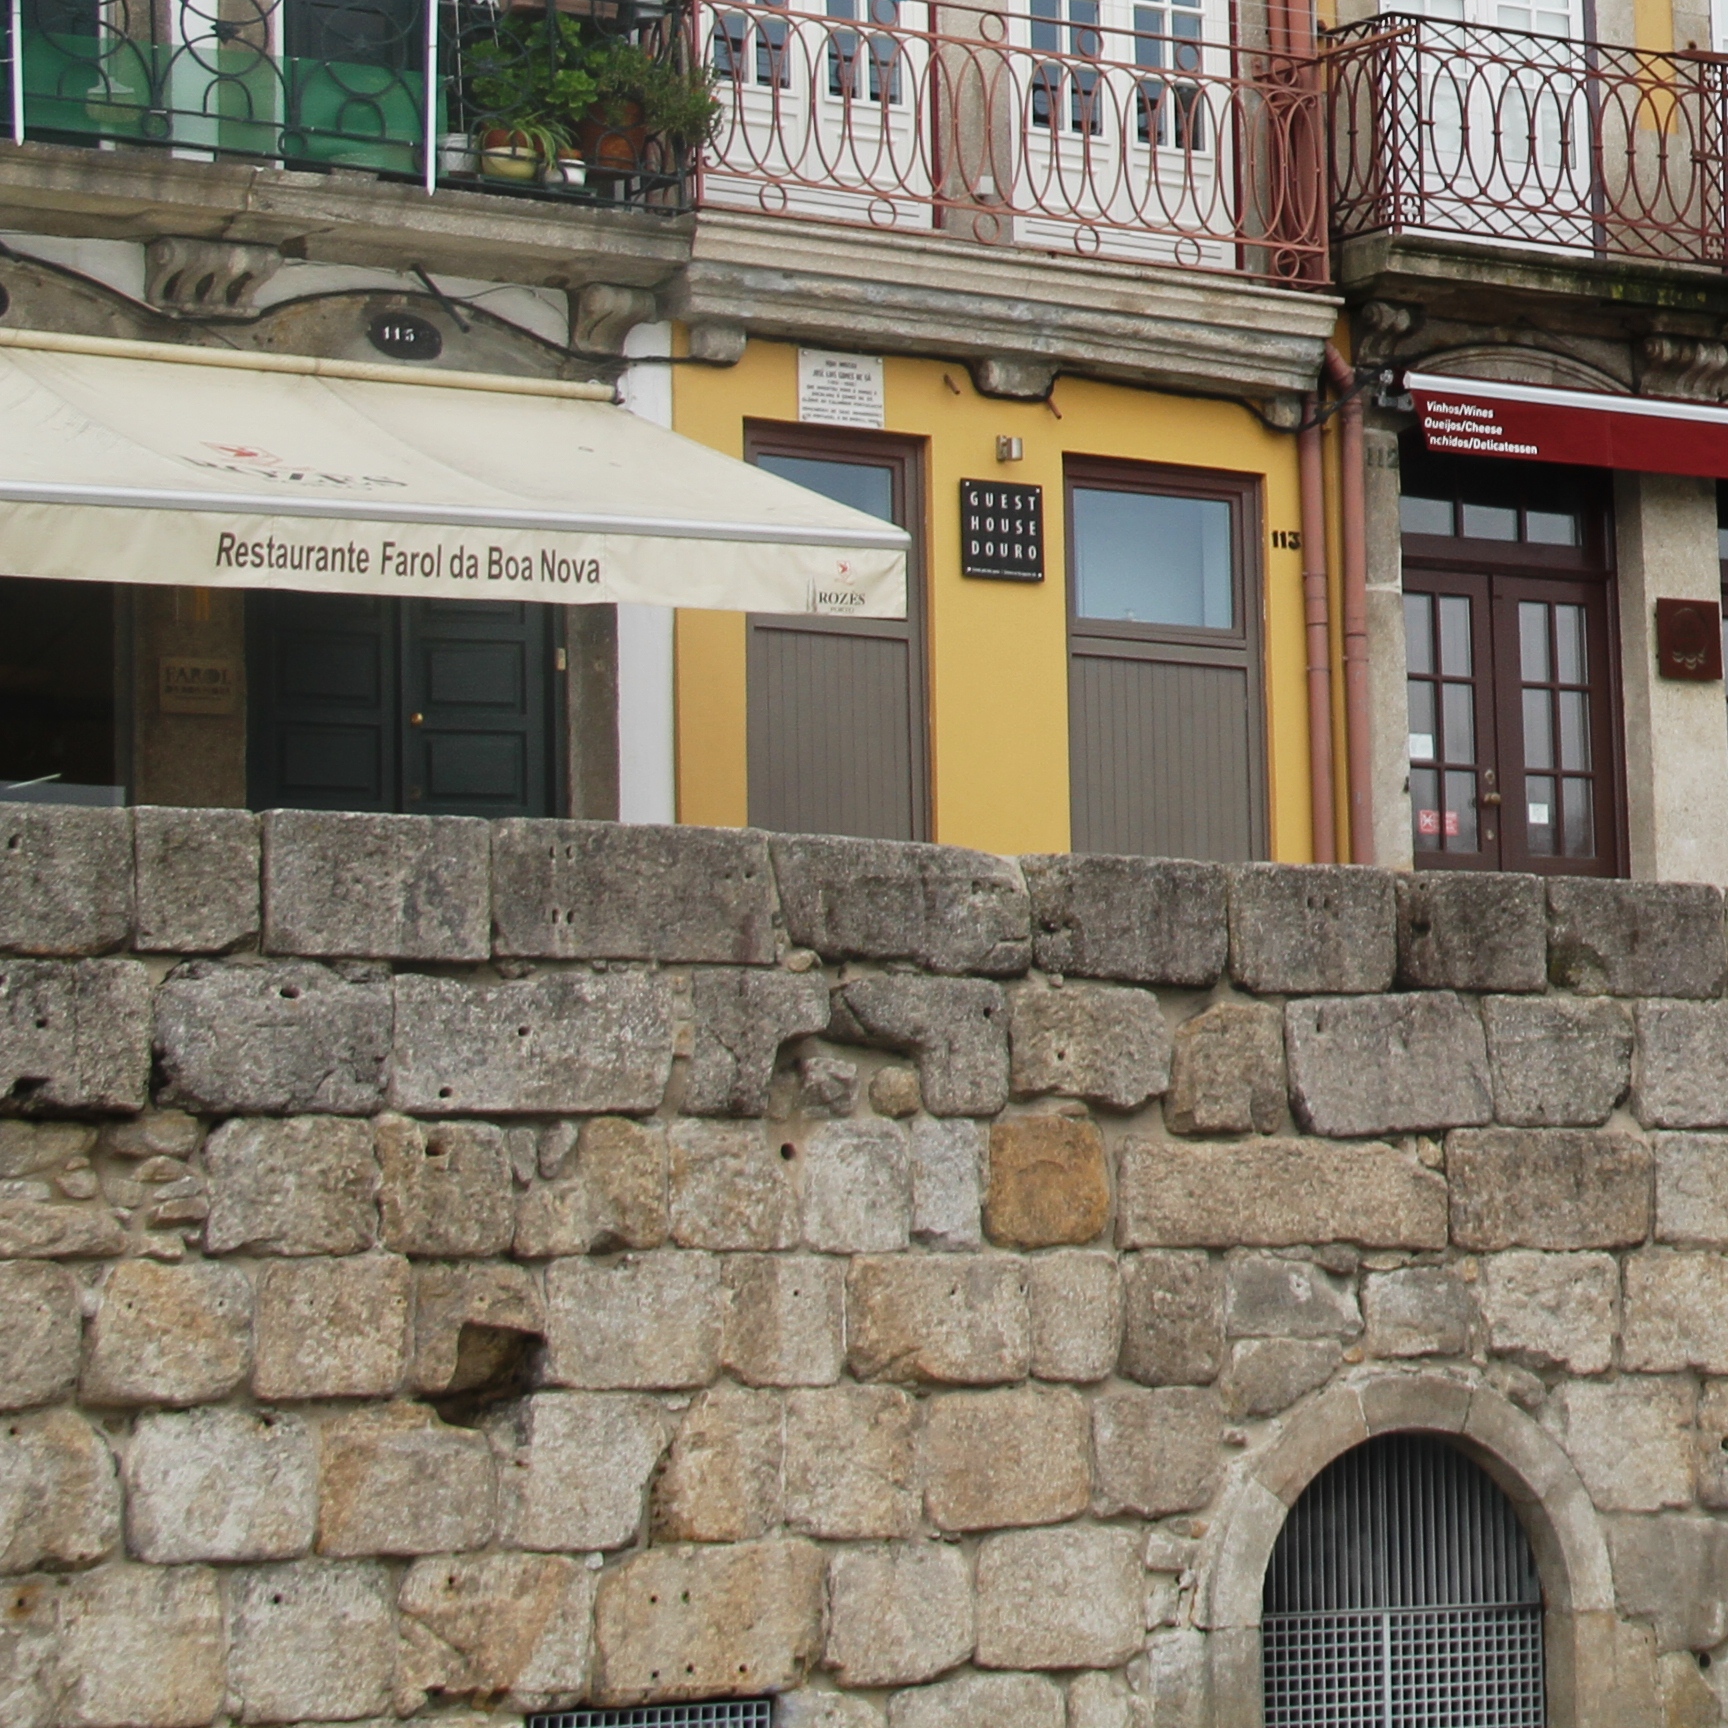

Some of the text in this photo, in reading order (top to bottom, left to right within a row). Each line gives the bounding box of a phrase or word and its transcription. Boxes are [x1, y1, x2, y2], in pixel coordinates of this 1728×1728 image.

[1426, 400, 1494, 419] Vinhos/Wines
[1427, 434, 1538, 455] nchidos/Delicatessen
[970, 491, 1036, 511] GUEST
[971, 515, 1036, 536] HOUSE
[971, 540, 1037, 561] DOURO
[1272, 530, 1301, 550] 113
[216, 532, 601, 584] Restaurante Farol da Boa Nova
